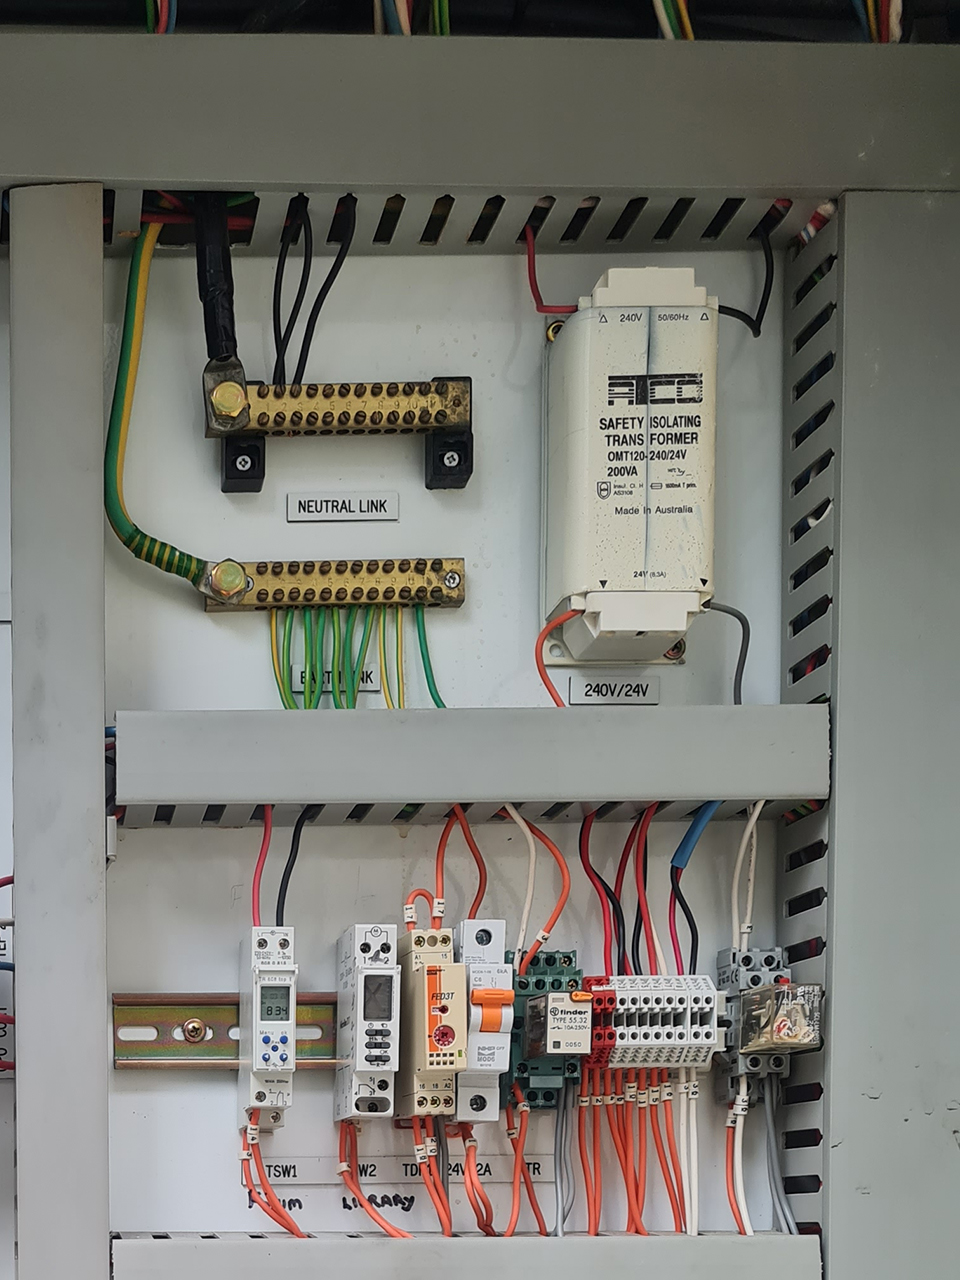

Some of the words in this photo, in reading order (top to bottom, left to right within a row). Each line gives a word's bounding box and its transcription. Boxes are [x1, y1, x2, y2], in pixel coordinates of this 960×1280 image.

[620, 314, 642, 322] 240V
[658, 314, 689, 322] 50/60Hz
[599, 417, 644, 430] SAFETY
[650, 415, 701, 428] ISOLATING
[607, 466, 638, 477] 200VA
[297, 500, 355, 514] NEUTRAL
[359, 499, 387, 513] LINK
[614, 507, 639, 515] Made
[655, 505, 693, 514] Australia
[584, 683, 649, 698] 240V/24V
[431, 992, 455, 1001] FED3T
[265, 1164, 298, 1178] TSW1
[342, 1193, 415, 1212] LIRARY
